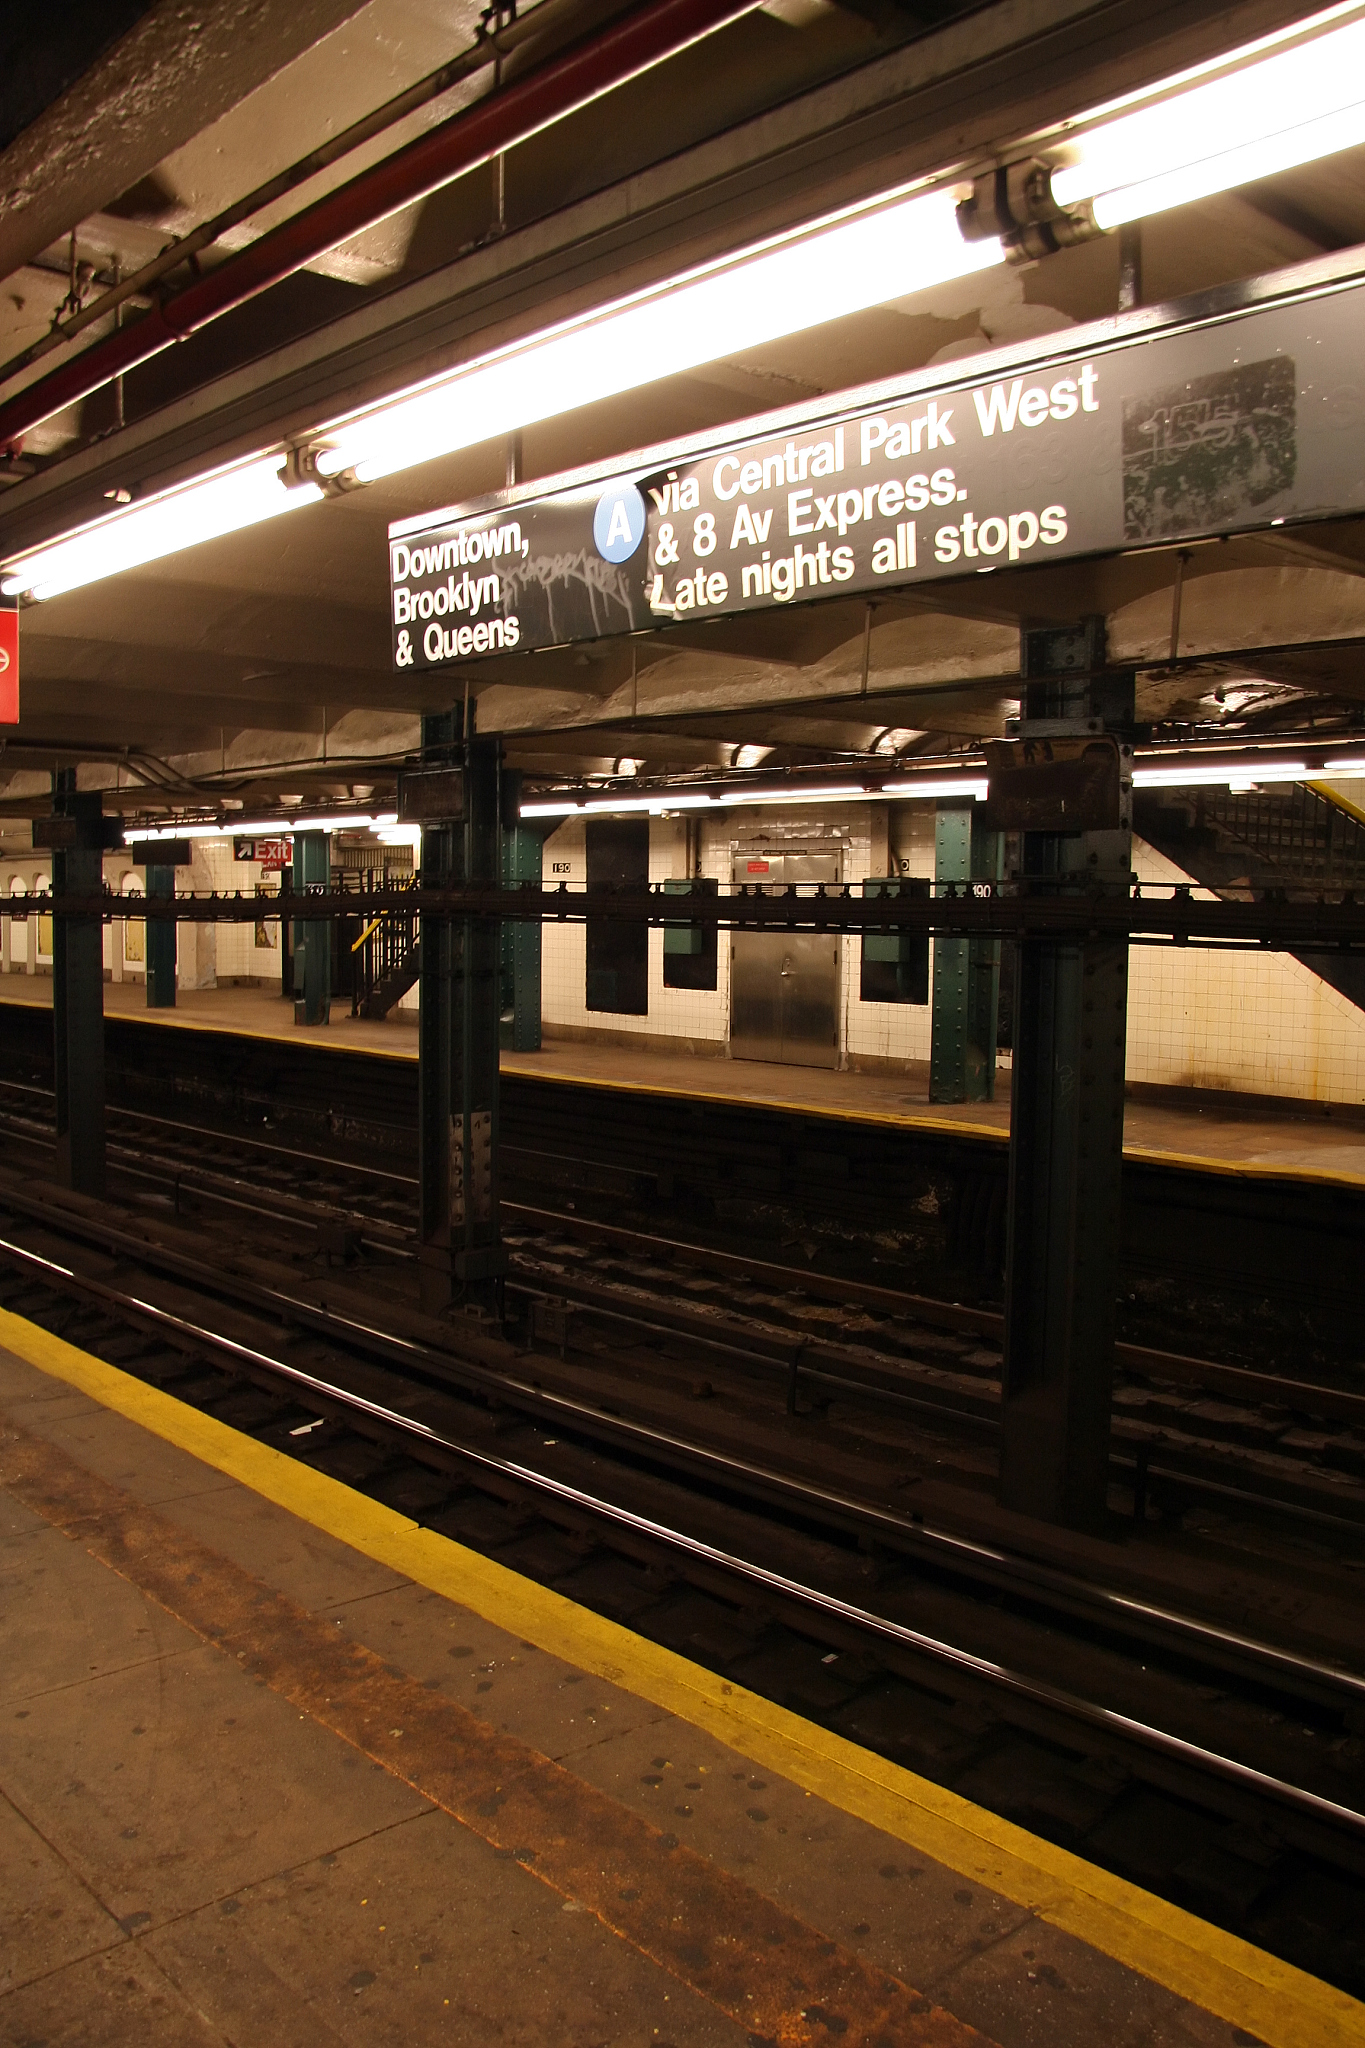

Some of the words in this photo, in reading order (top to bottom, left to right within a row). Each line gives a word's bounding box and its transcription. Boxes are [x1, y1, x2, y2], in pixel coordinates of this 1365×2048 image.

[648, 471, 700, 516] via
[712, 426, 845, 501] Central
[860, 401, 956, 466] Park
[972, 364, 1099, 437] West
[606, 499, 633, 547] A
[654, 523, 680, 566] &
[693, 512, 717, 557] 8
[730, 503, 773, 550] Av
[788, 467, 967, 536] Express.
[393, 522, 530, 583] Downtown,
[650, 567, 728, 612] Late
[741, 541, 855, 602] nights
[871, 521, 917, 574] all
[934, 505, 1068, 562] stops
[393, 571, 500, 625] Brooklyn
[395, 629, 415, 667] &
[423, 616, 520, 663] Queens
[254, 841, 289, 859] Exit
[554, 863, 571, 873] 190
[972, 884, 991, 898] 190
